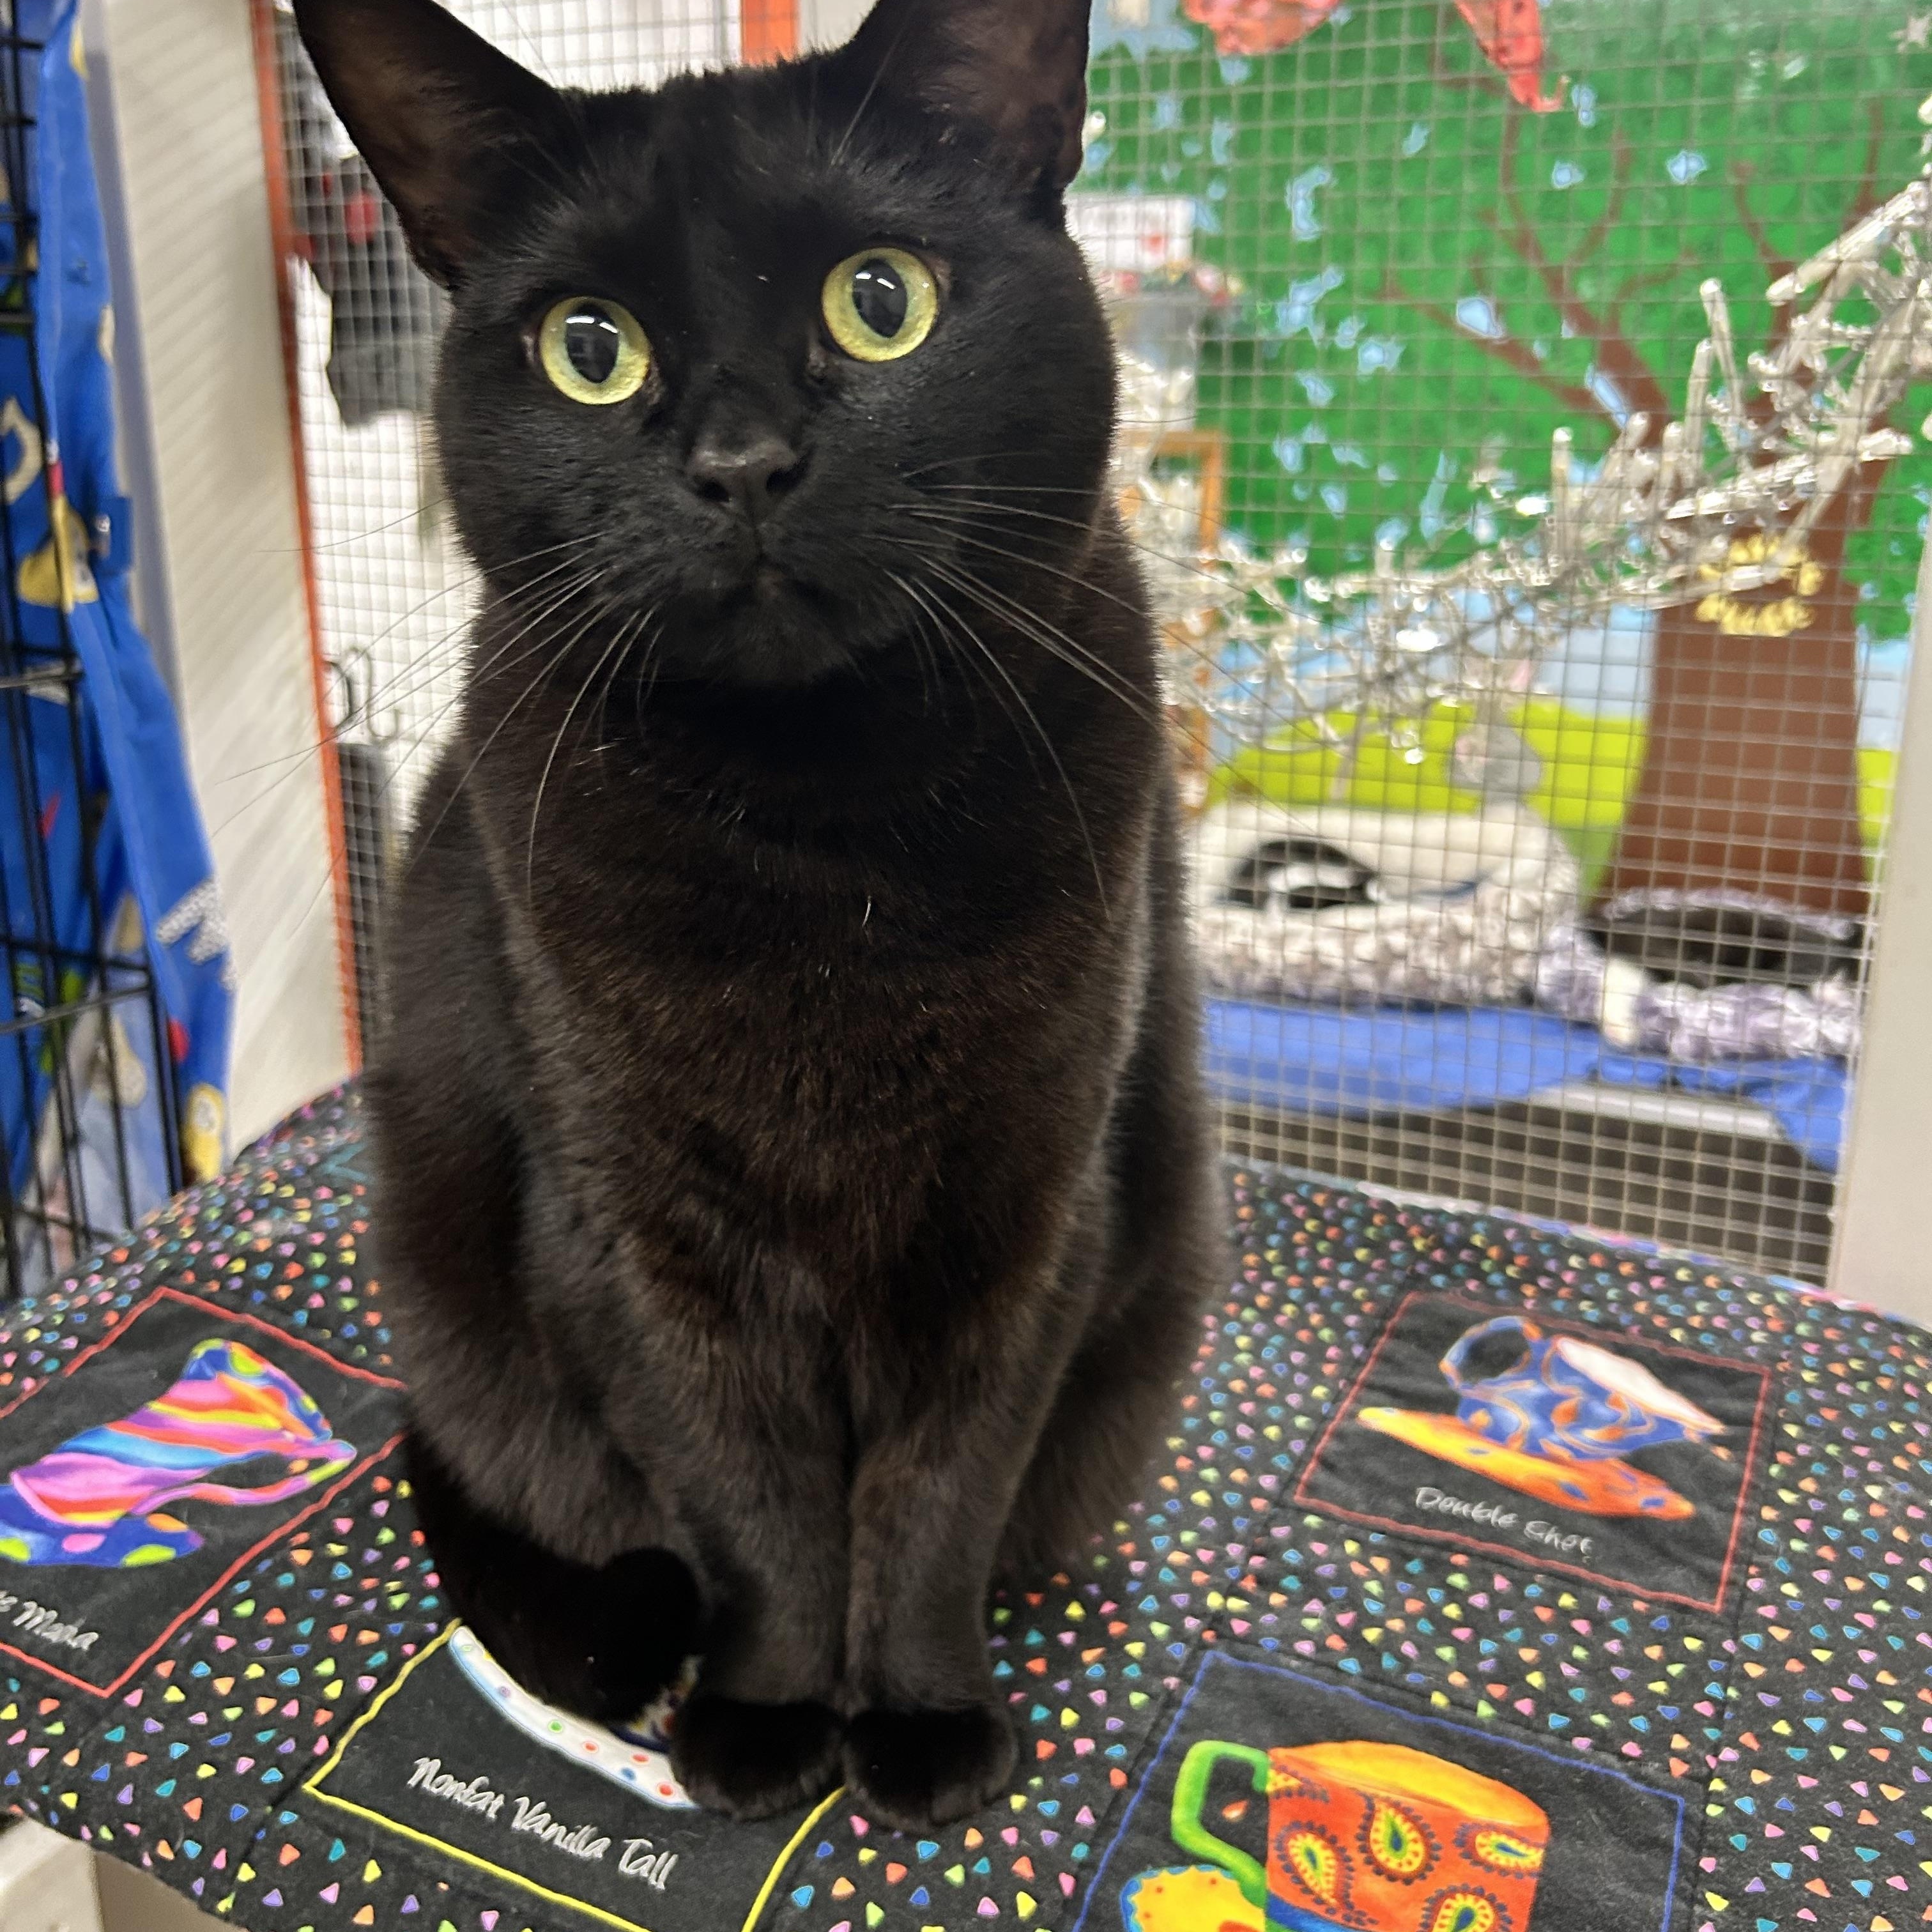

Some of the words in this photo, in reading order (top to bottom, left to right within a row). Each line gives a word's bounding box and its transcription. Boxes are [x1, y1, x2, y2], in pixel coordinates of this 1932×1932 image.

[1415, 1486, 1519, 1529] Double
[406, 1757, 505, 1820] Nonfat
[511, 1796, 611, 1859] Vanilla
[618, 1838, 679, 1891] Tall
